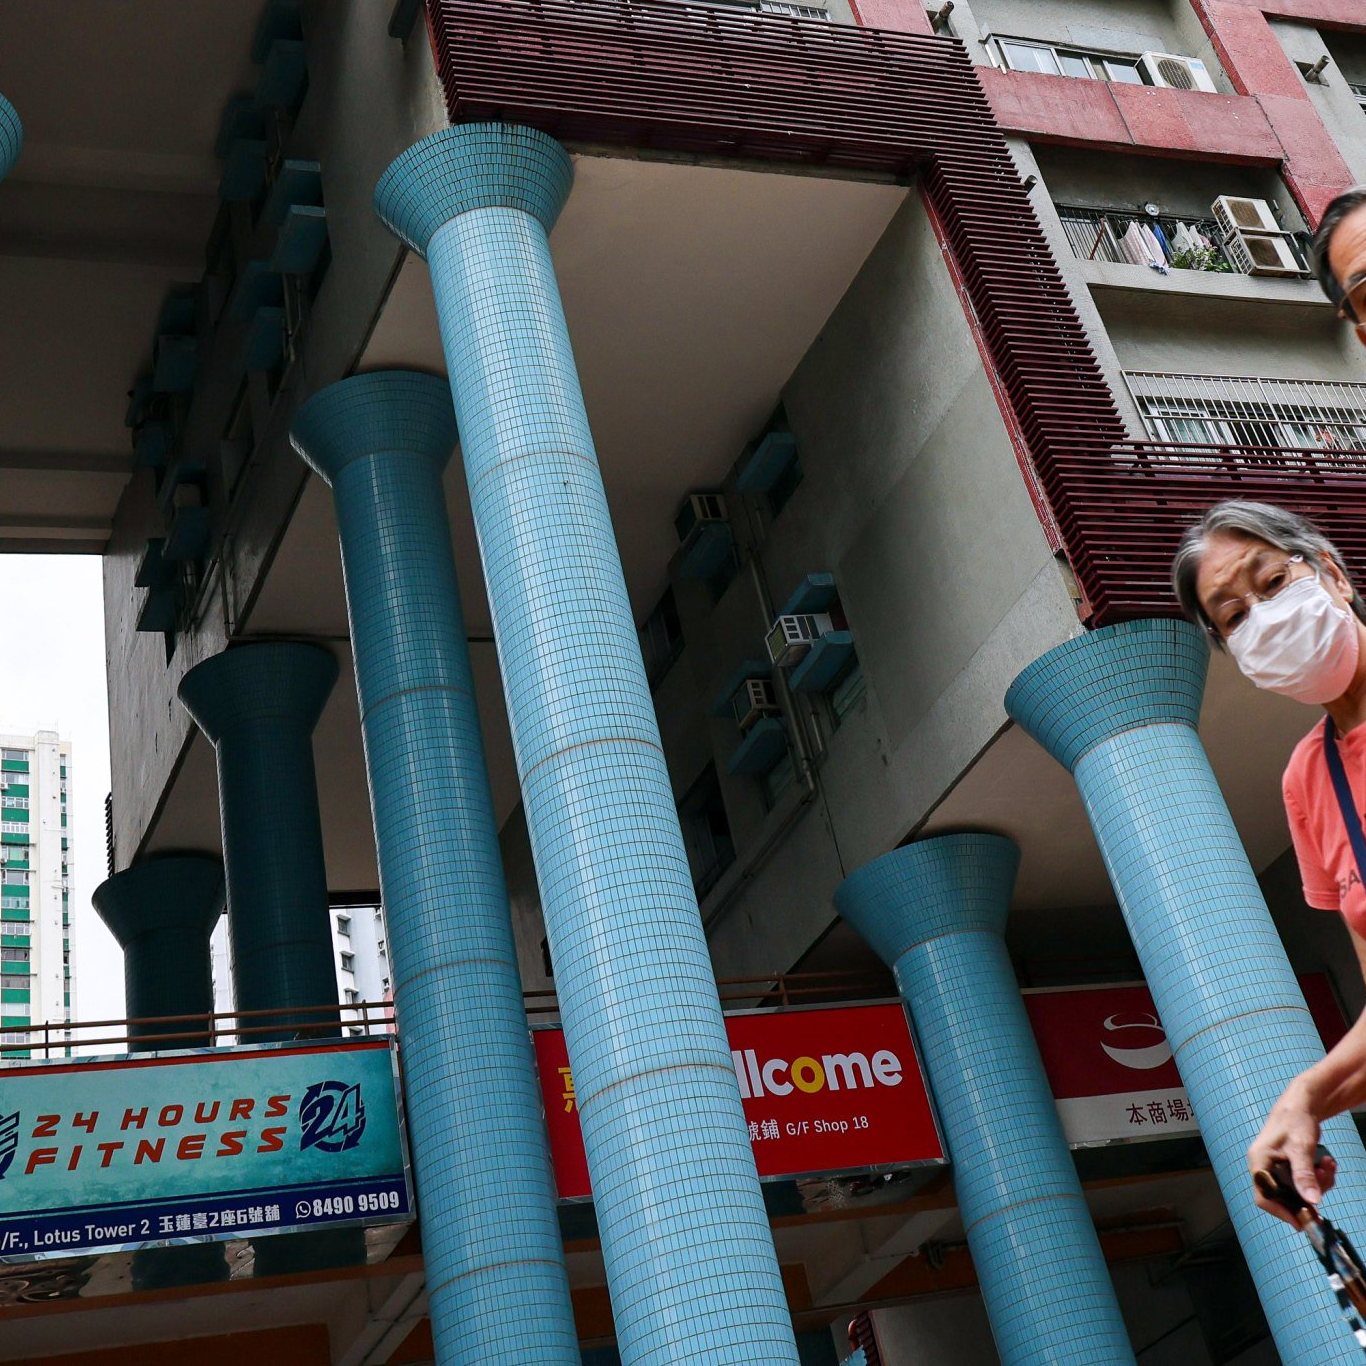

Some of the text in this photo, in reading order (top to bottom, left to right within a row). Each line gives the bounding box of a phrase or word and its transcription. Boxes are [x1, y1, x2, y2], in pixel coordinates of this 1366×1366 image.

[731, 1048, 904, 1100] llcome
[31, 1094, 292, 1138] 24 HOURS
[786, 1115, 870, 1137] G/F Shop 18
[24, 1126, 287, 1175] FITNESS
[312, 1190, 400, 1217] 8490 9509
[34, 1229, 81, 1246] Lotus
[85, 1223, 136, 1241] Tower
[140, 1219, 150, 1234] 2
